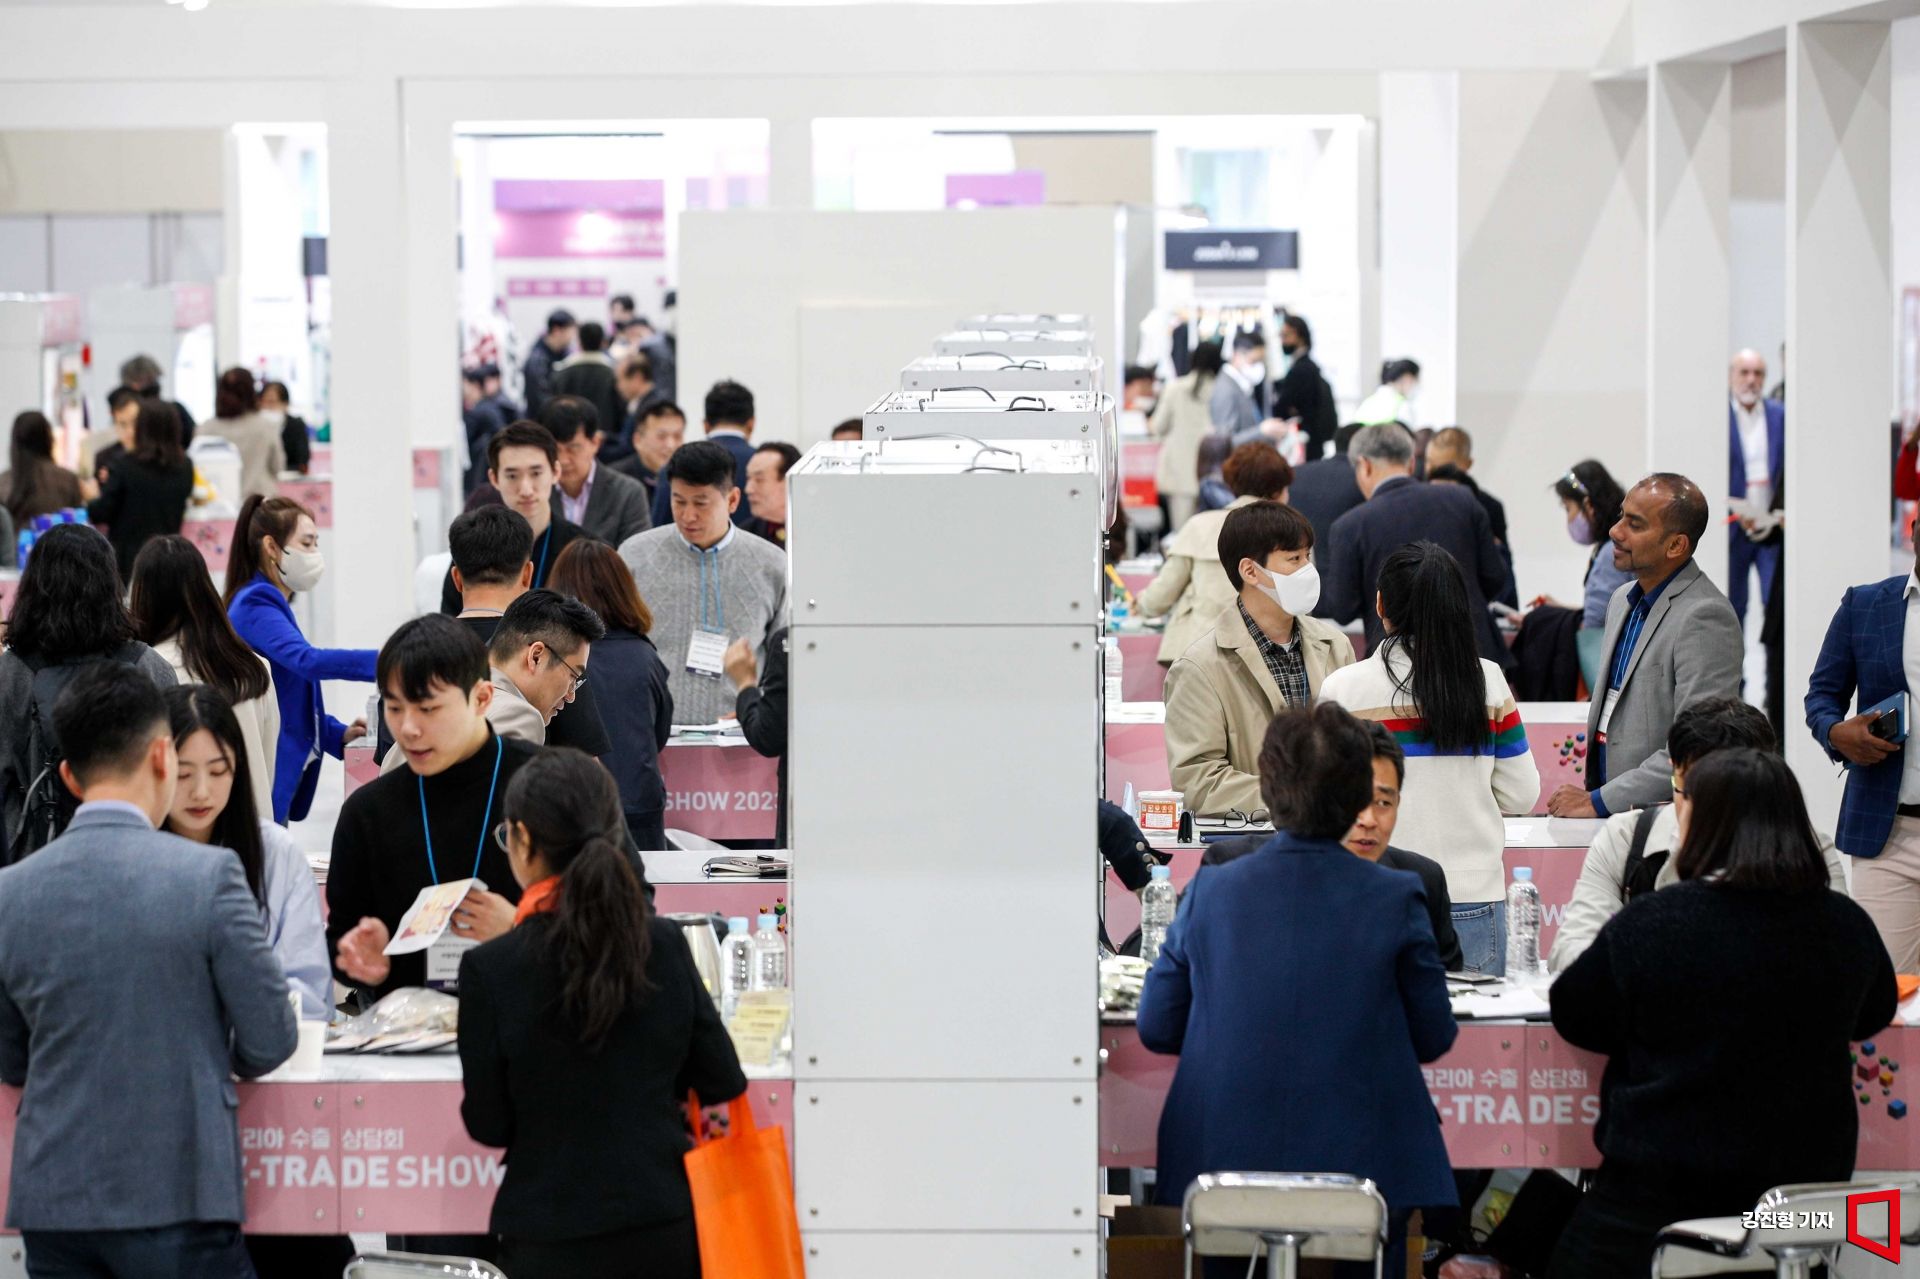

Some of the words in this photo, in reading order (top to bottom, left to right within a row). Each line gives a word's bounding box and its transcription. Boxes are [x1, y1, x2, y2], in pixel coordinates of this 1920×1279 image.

[666, 791, 729, 811] SHOW
[1481, 1068, 1518, 1088] 수출
[1529, 1069, 1588, 1089] 상담회
[1431, 1094, 1574, 1124] -TRADE
[241, 1127, 284, 1149] 리아
[290, 1127, 331, 1149] 수출
[342, 1127, 404, 1150] 상담회
[242, 1155, 389, 1188] -TRADE
[396, 1155, 507, 1188] SHOW
